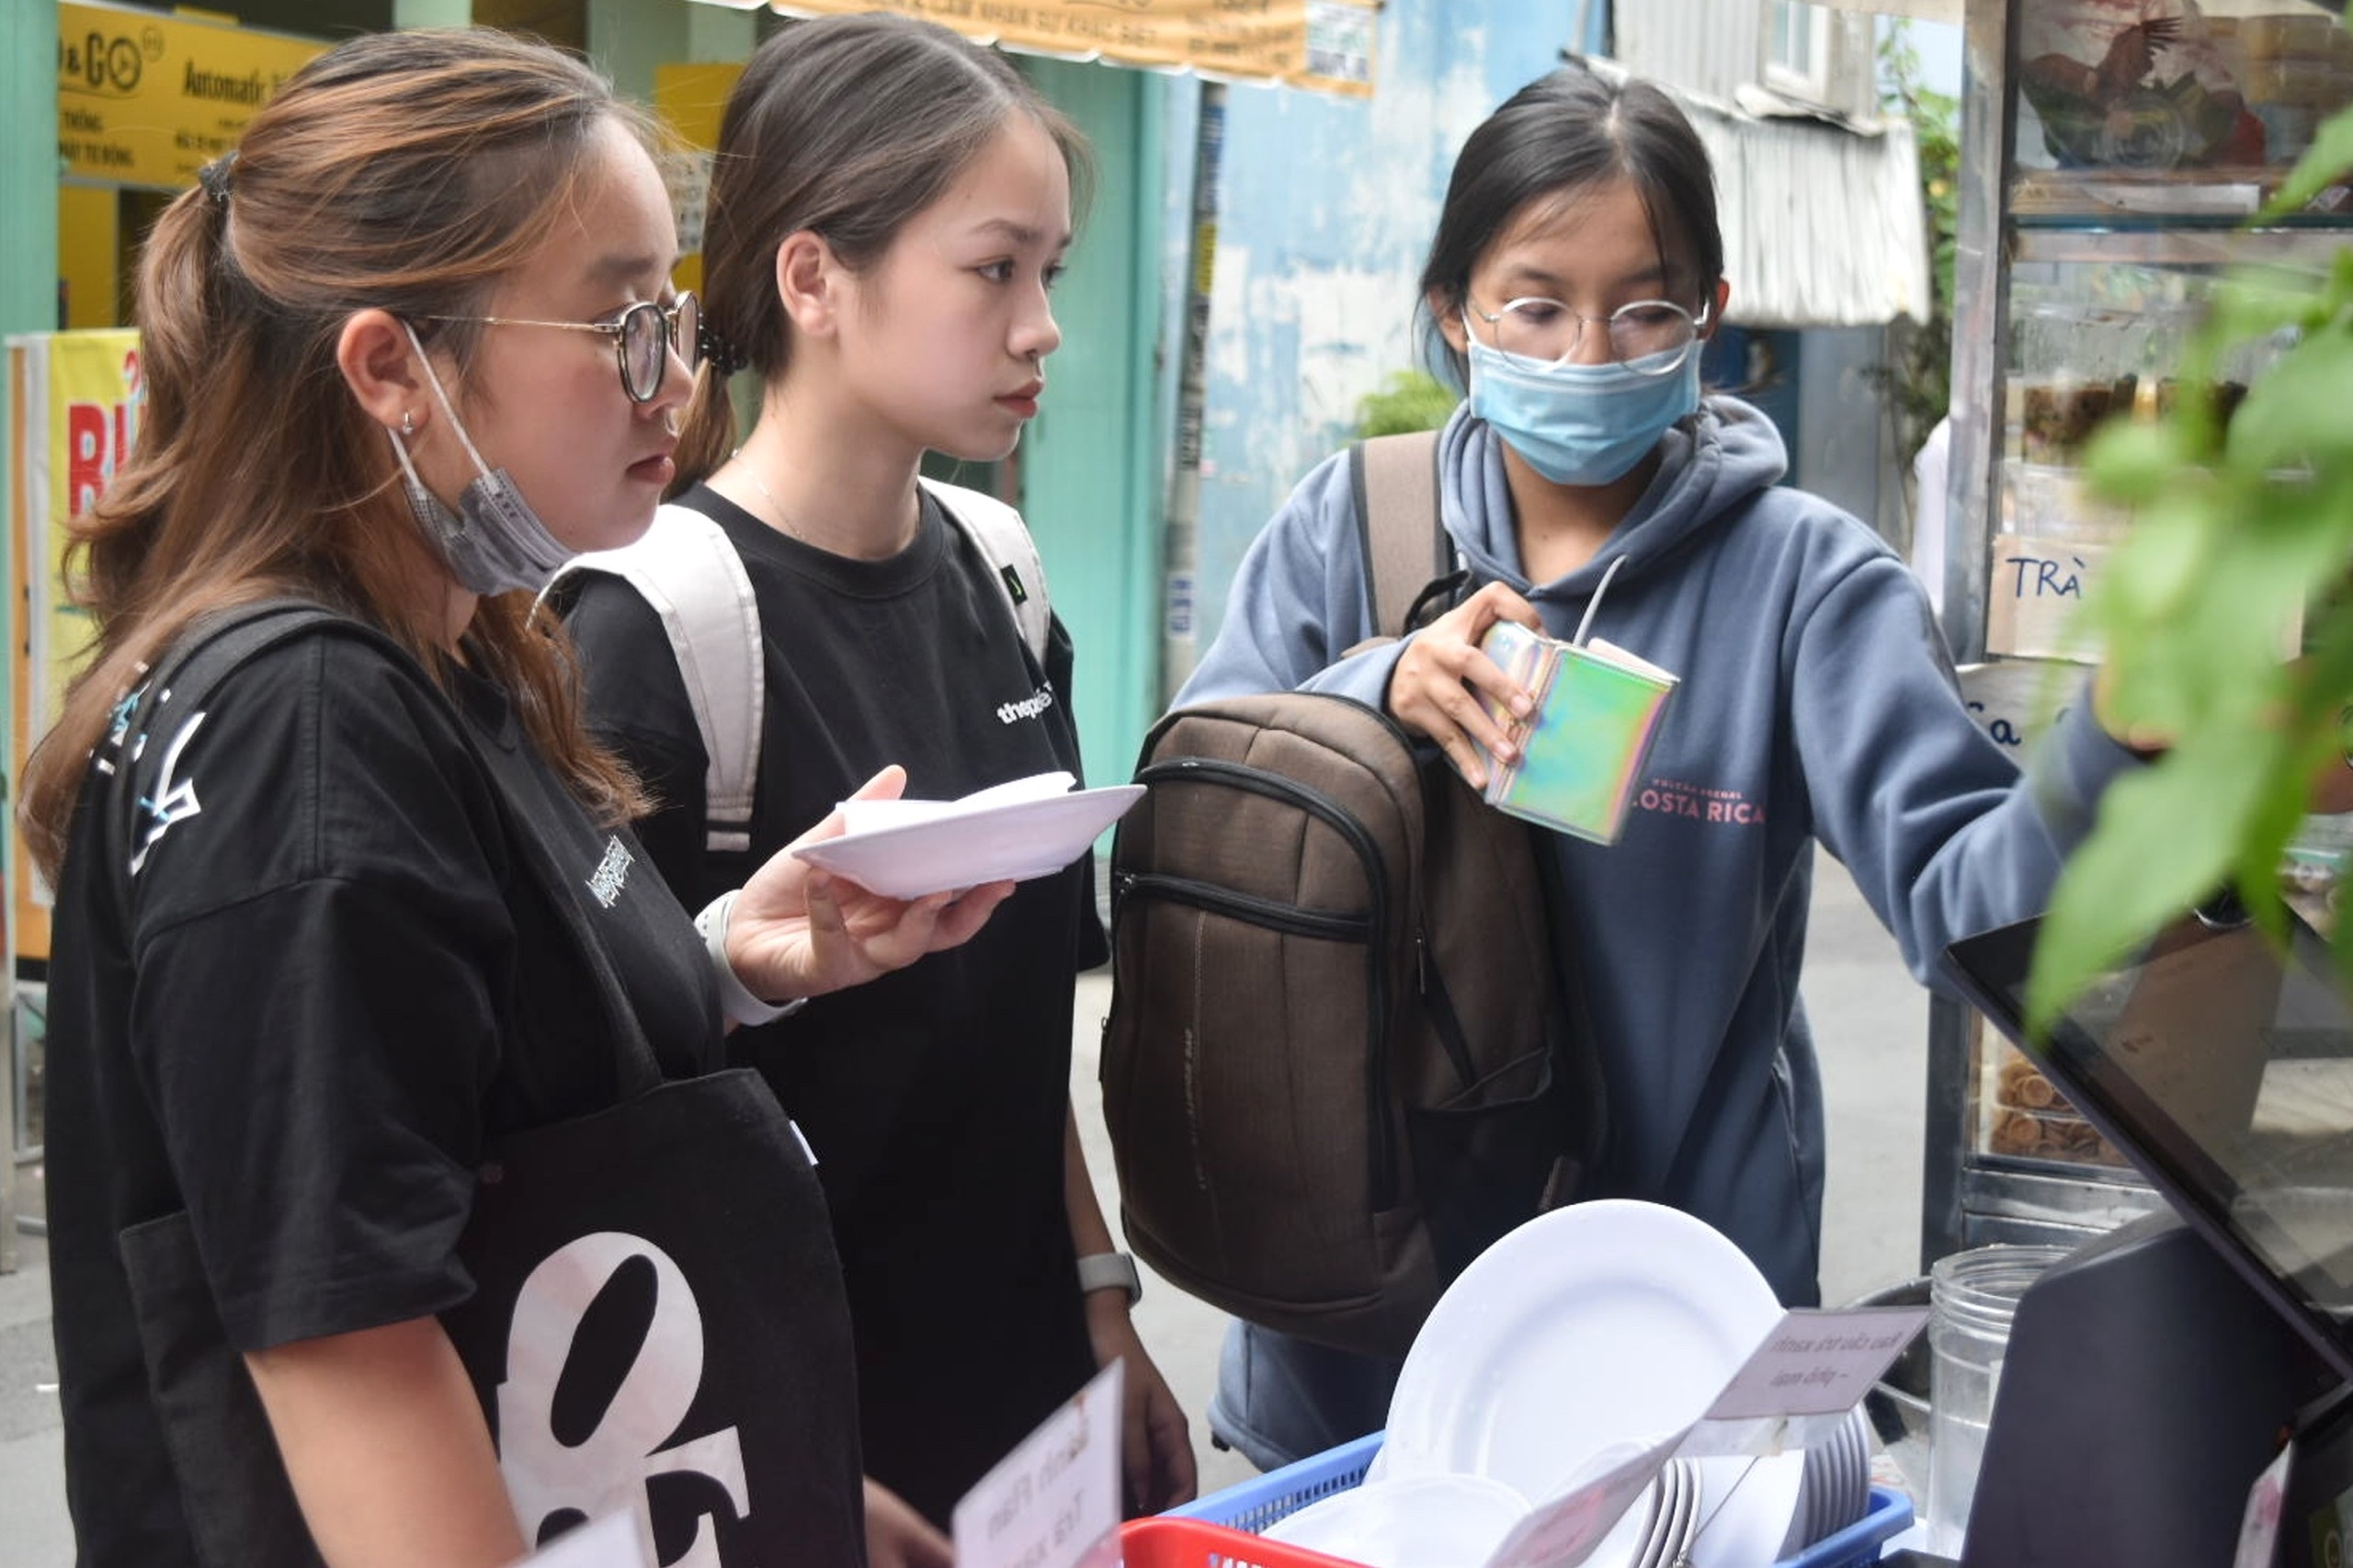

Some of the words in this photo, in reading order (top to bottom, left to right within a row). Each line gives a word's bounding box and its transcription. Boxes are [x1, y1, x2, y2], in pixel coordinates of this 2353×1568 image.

[2006, 556, 2086, 599] TRÀ
[1632, 788, 1699, 819] OSTA
[1706, 800, 1767, 825] RICA
